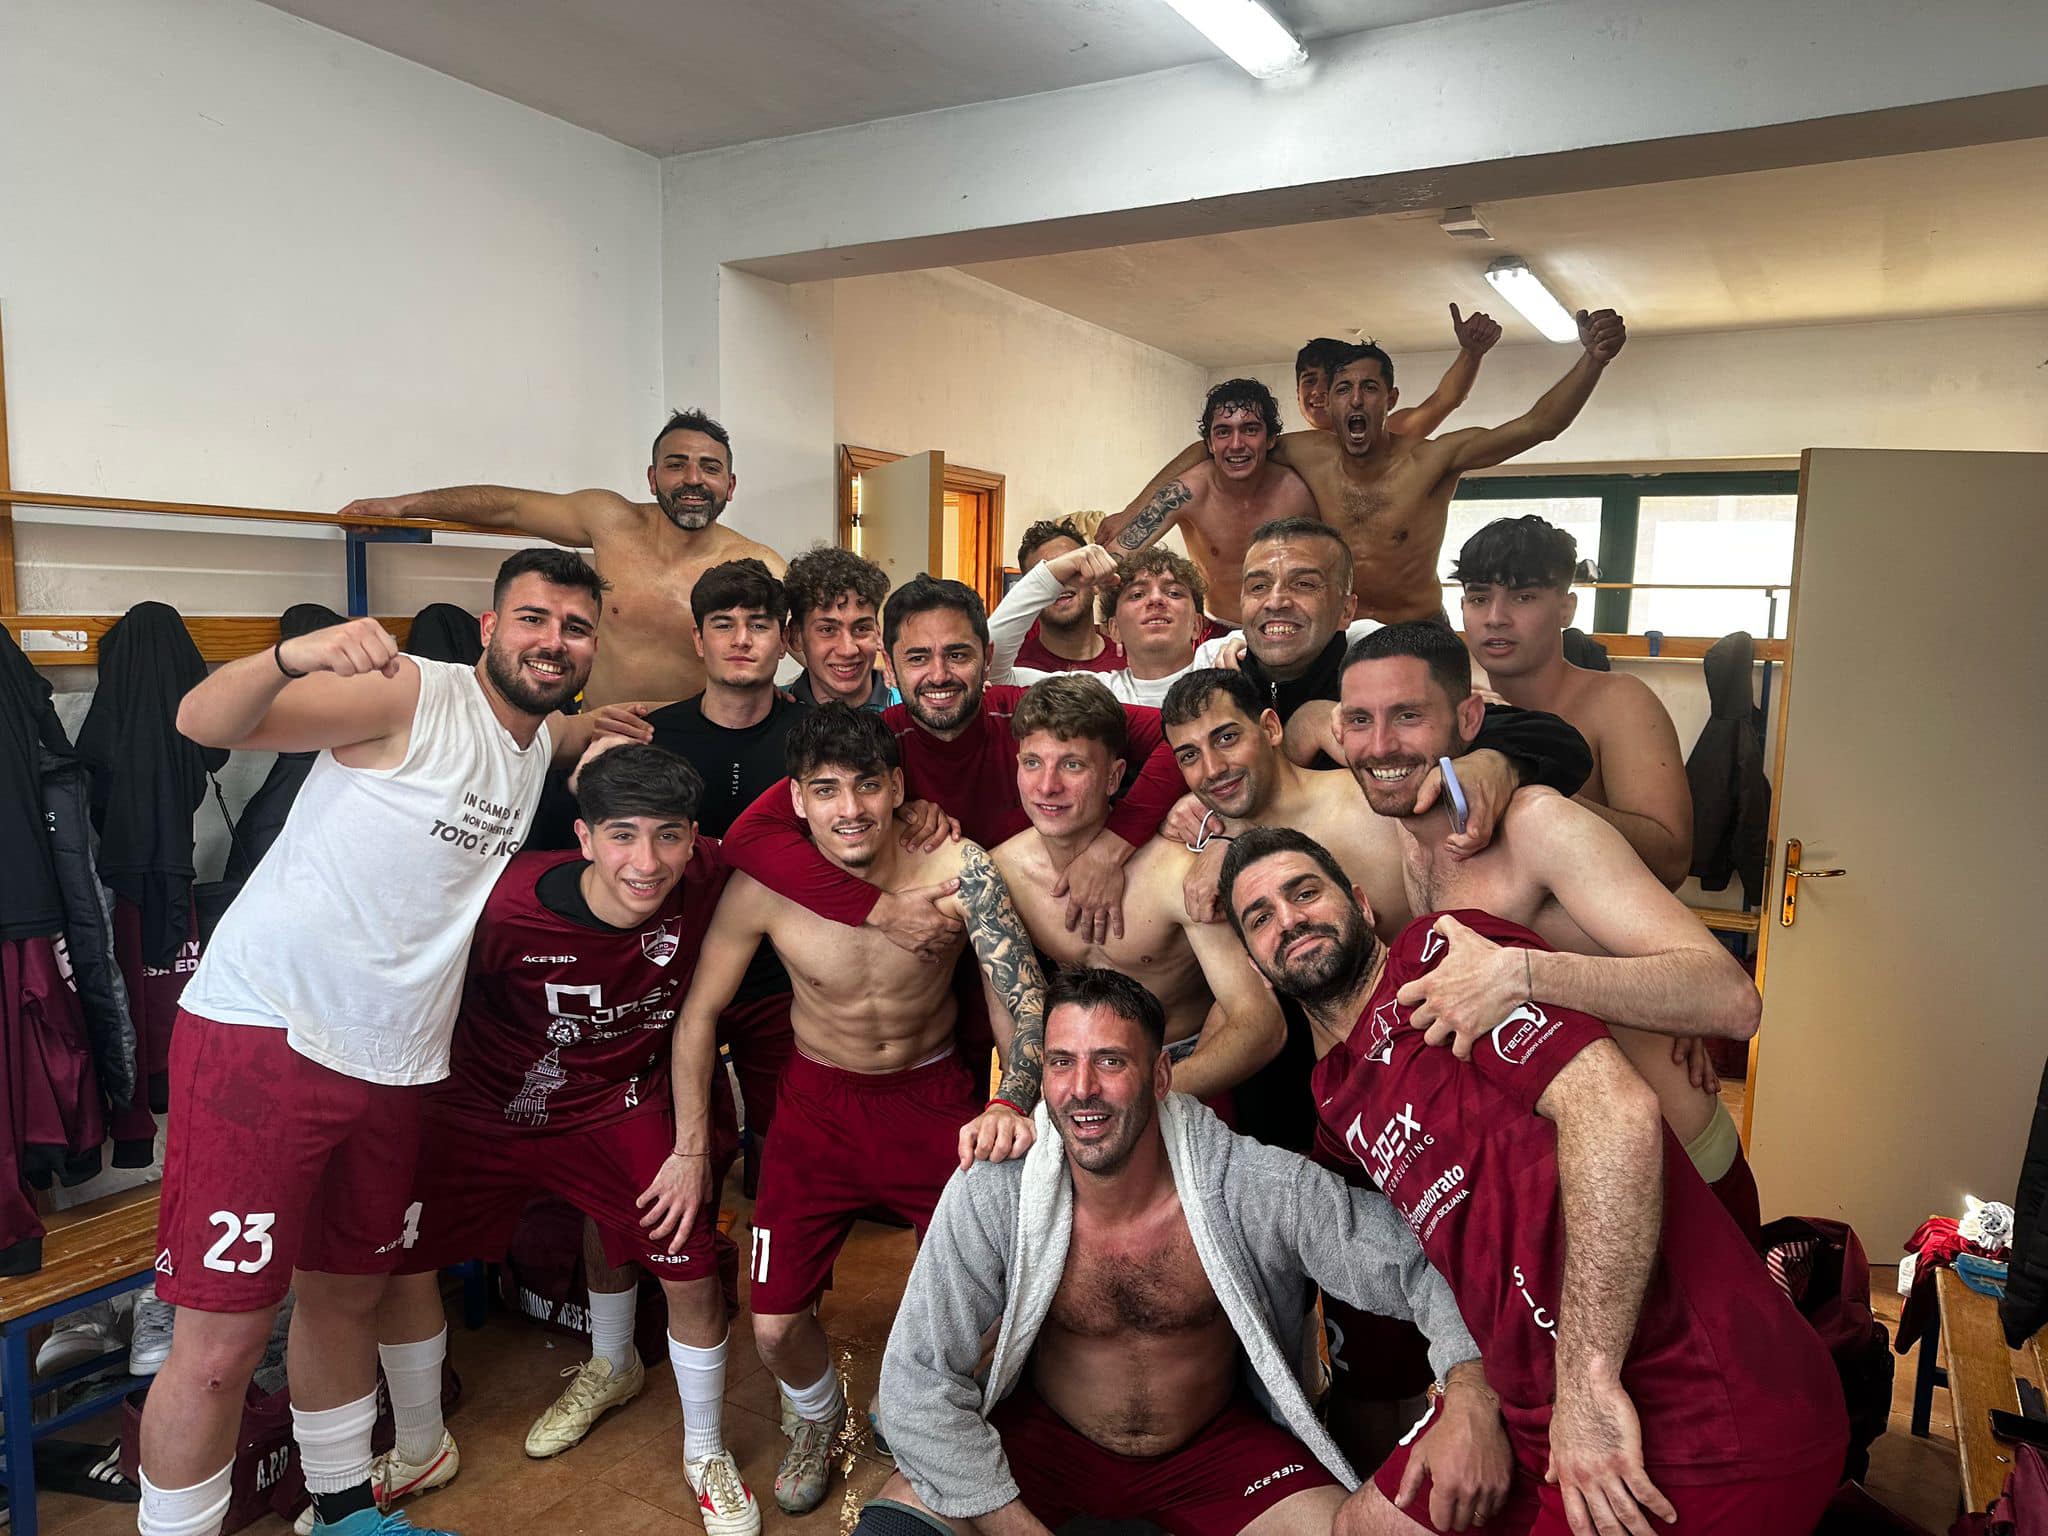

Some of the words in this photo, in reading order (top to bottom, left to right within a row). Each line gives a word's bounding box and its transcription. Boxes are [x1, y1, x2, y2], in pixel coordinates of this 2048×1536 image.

[463, 791, 478, 808] IN
[731, 762, 740, 796] KIPSTA
[1387, 1133, 1436, 1194] CONSULTING
[203, 1209, 276, 1274] 23
